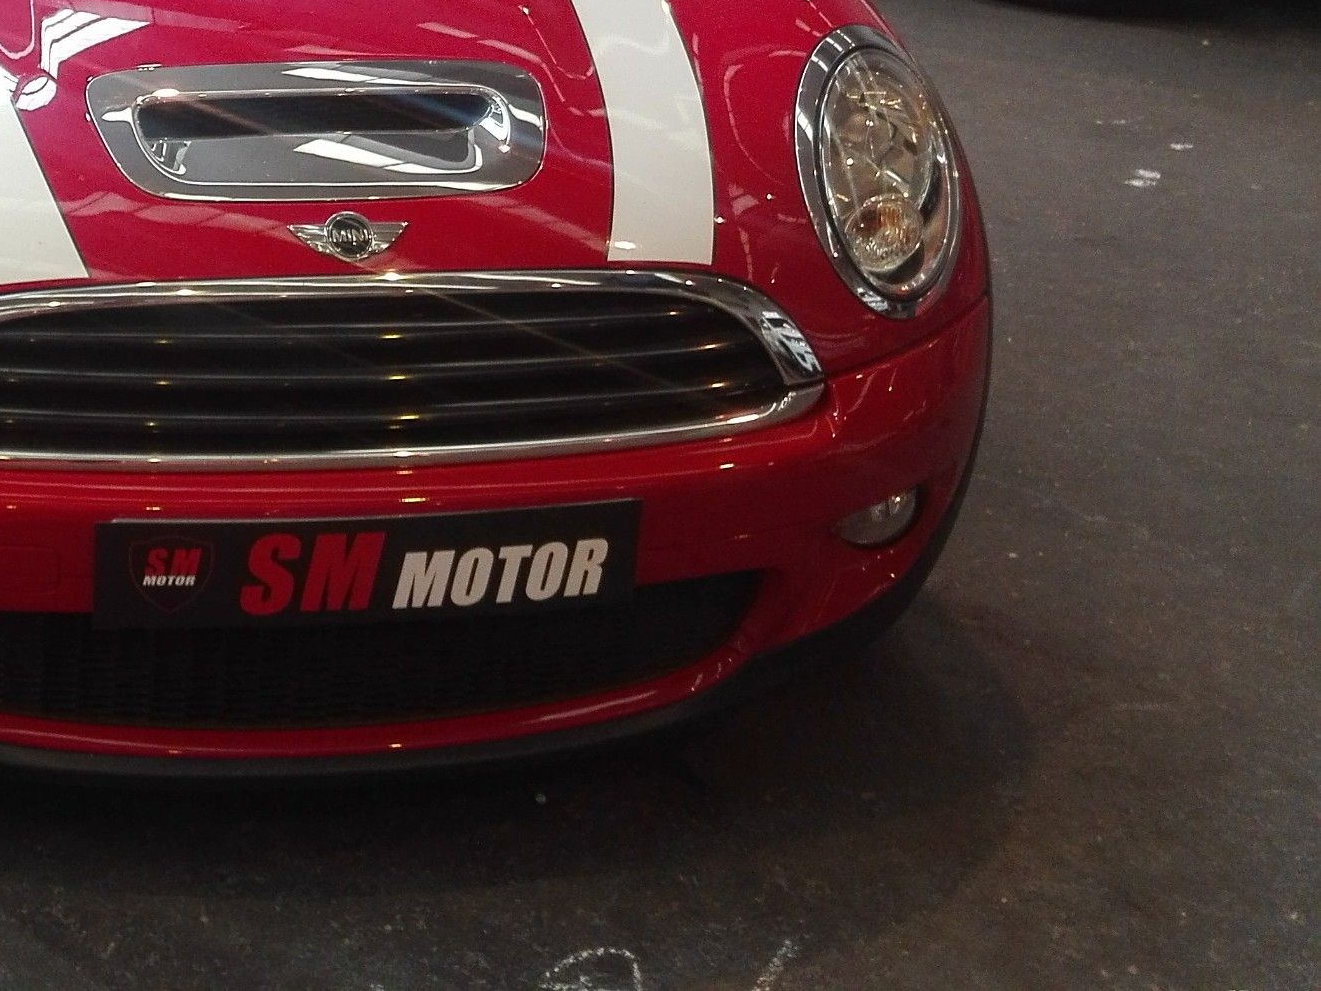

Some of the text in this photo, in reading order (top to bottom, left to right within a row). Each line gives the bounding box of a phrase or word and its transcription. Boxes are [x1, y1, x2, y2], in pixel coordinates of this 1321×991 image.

[331, 228, 369, 242] MINI
[144, 548, 202, 576] SM
[142, 575, 197, 586] MOTOR
[240, 530, 609, 616] SM MOTOR
